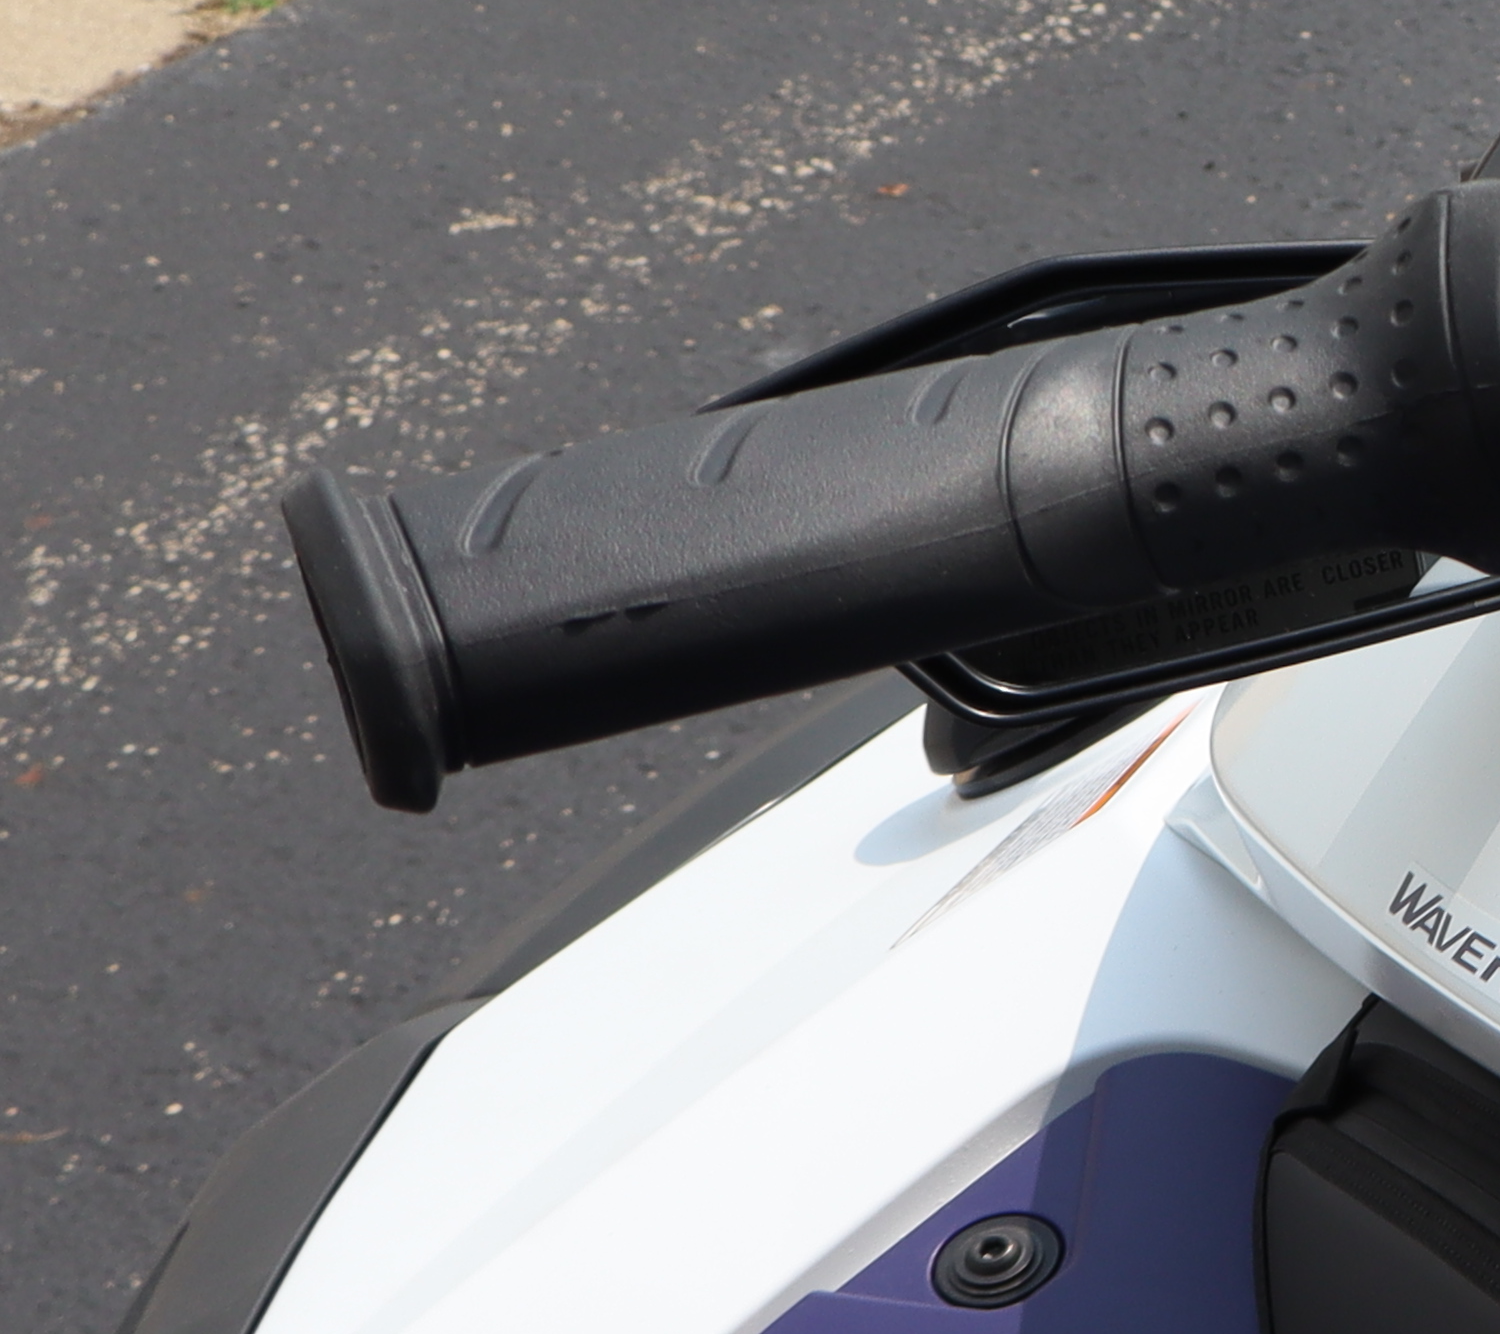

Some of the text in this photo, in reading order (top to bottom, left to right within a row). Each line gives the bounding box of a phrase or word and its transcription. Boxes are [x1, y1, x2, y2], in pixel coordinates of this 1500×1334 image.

[1167, 587, 1253, 621] MIRROR
[1263, 572, 1305, 600] ARE
[1321, 549, 1404, 586] CLOSER
[1174, 607, 1260, 644] APPEAR
